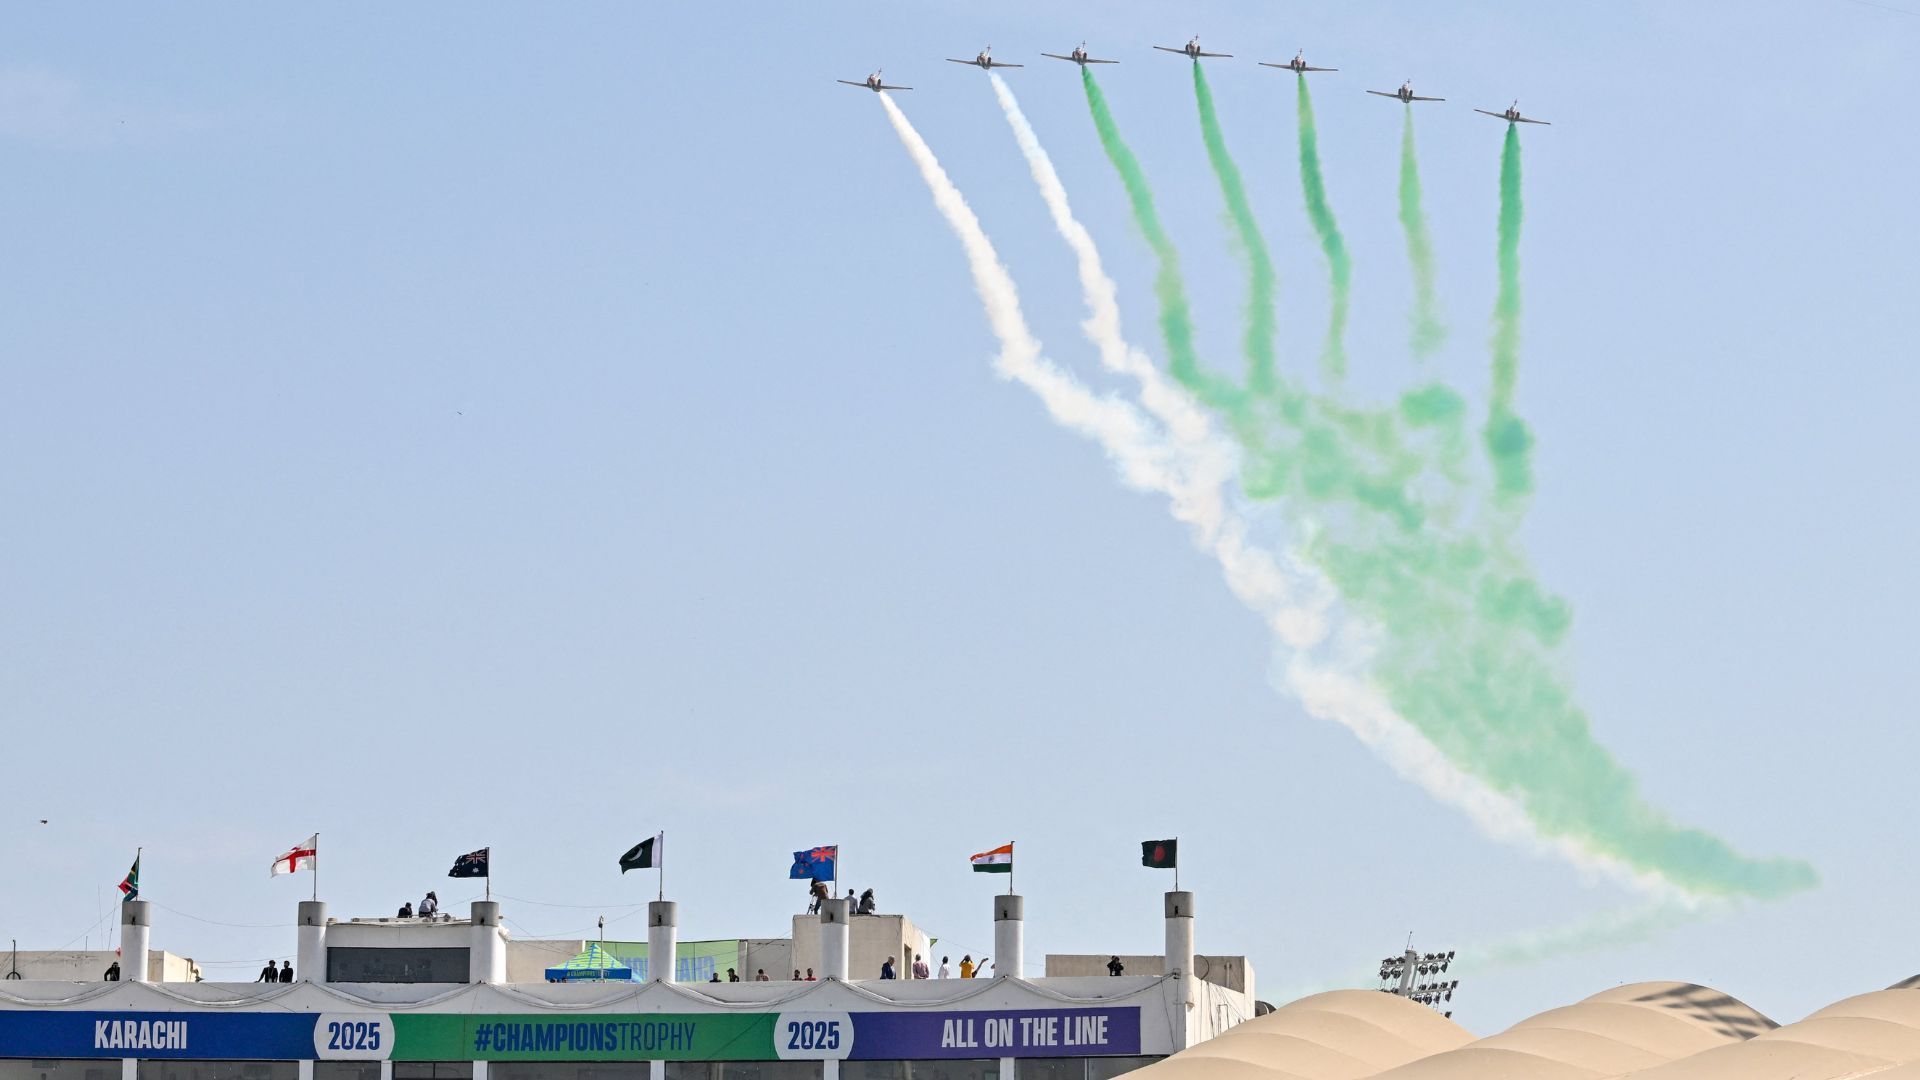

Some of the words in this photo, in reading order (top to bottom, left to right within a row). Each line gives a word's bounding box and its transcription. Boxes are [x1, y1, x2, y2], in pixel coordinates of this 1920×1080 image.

[95, 1021, 186, 1049] KARACHI
[328, 1022, 380, 1051] 2025
[475, 1022, 695, 1052] #CHAMPIONSTROPHY
[788, 1021, 839, 1050] 2025
[942, 1020, 977, 1047] ALL
[985, 1019, 1013, 1047] ON
[1020, 1017, 1057, 1046] THE
[1064, 1015, 1108, 1045] LINE
